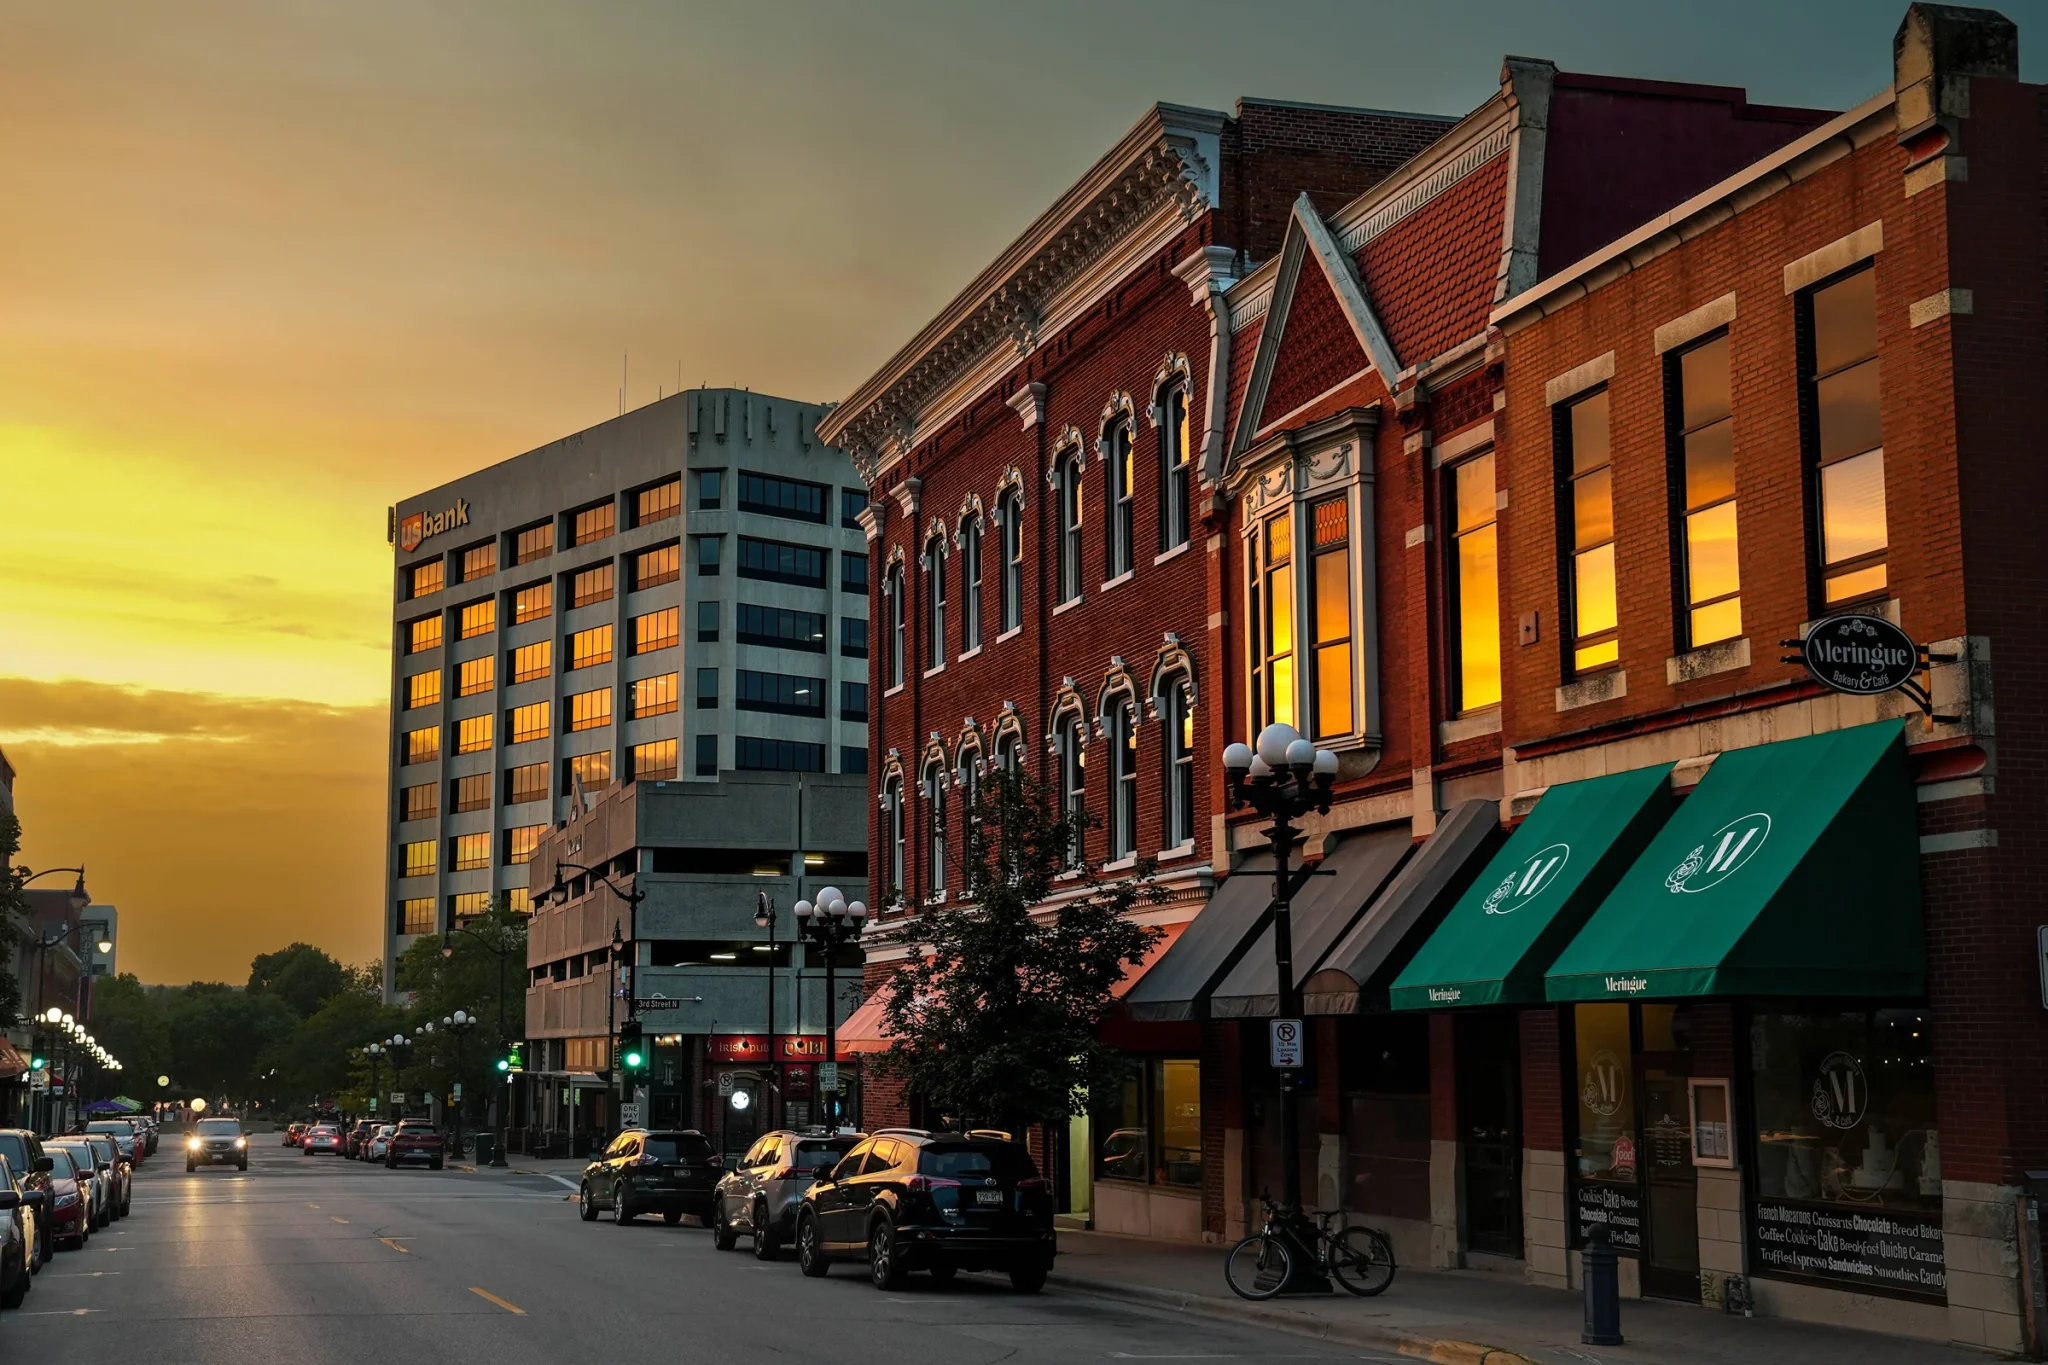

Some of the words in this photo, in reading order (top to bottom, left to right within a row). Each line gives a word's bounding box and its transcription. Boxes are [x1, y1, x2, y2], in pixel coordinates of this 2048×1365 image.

[423, 498, 469, 539] bank
[1814, 638, 1908, 672] Meringue
[1833, 670, 1859, 688] Bakery
[1860, 671, 1872, 689] &
[1872, 673, 1889, 687] Café
[1428, 988, 1461, 1004] Meringue
[1605, 976, 1647, 995] Meringue
[638, 1000, 650, 1008] 3rd
[651, 1000, 671, 1008] Street
[672, 1000, 678, 1008] N
[1828, 1070, 1856, 1113] M
[1578, 1188, 1602, 1204] Cookies
[1603, 1188, 1620, 1208] Cake
[1580, 1206, 1607, 1223] Chocolate
[1758, 1203, 1779, 1221] French
[1779, 1205, 1811, 1225] Macarons
[1812, 1211, 1853, 1230] Croissants
[1853, 1214, 1891, 1235] Chocolate
[1891, 1221, 1919, 1240] Bread
[1758, 1227, 1785, 1243] Coffee
[1785, 1228, 1817, 1247] Cookies
[1817, 1229, 1838, 1253] Cake
[1839, 1238, 1879, 1256] Breakfast
[1880, 1240, 1909, 1260] Quiche
[1760, 1247, 1793, 1265] Truffles
[1828, 1255, 1873, 1276] Sandwiches
[1873, 1264, 1920, 1283] Smoothies
[1919, 1268, 1947, 1289] Candy
